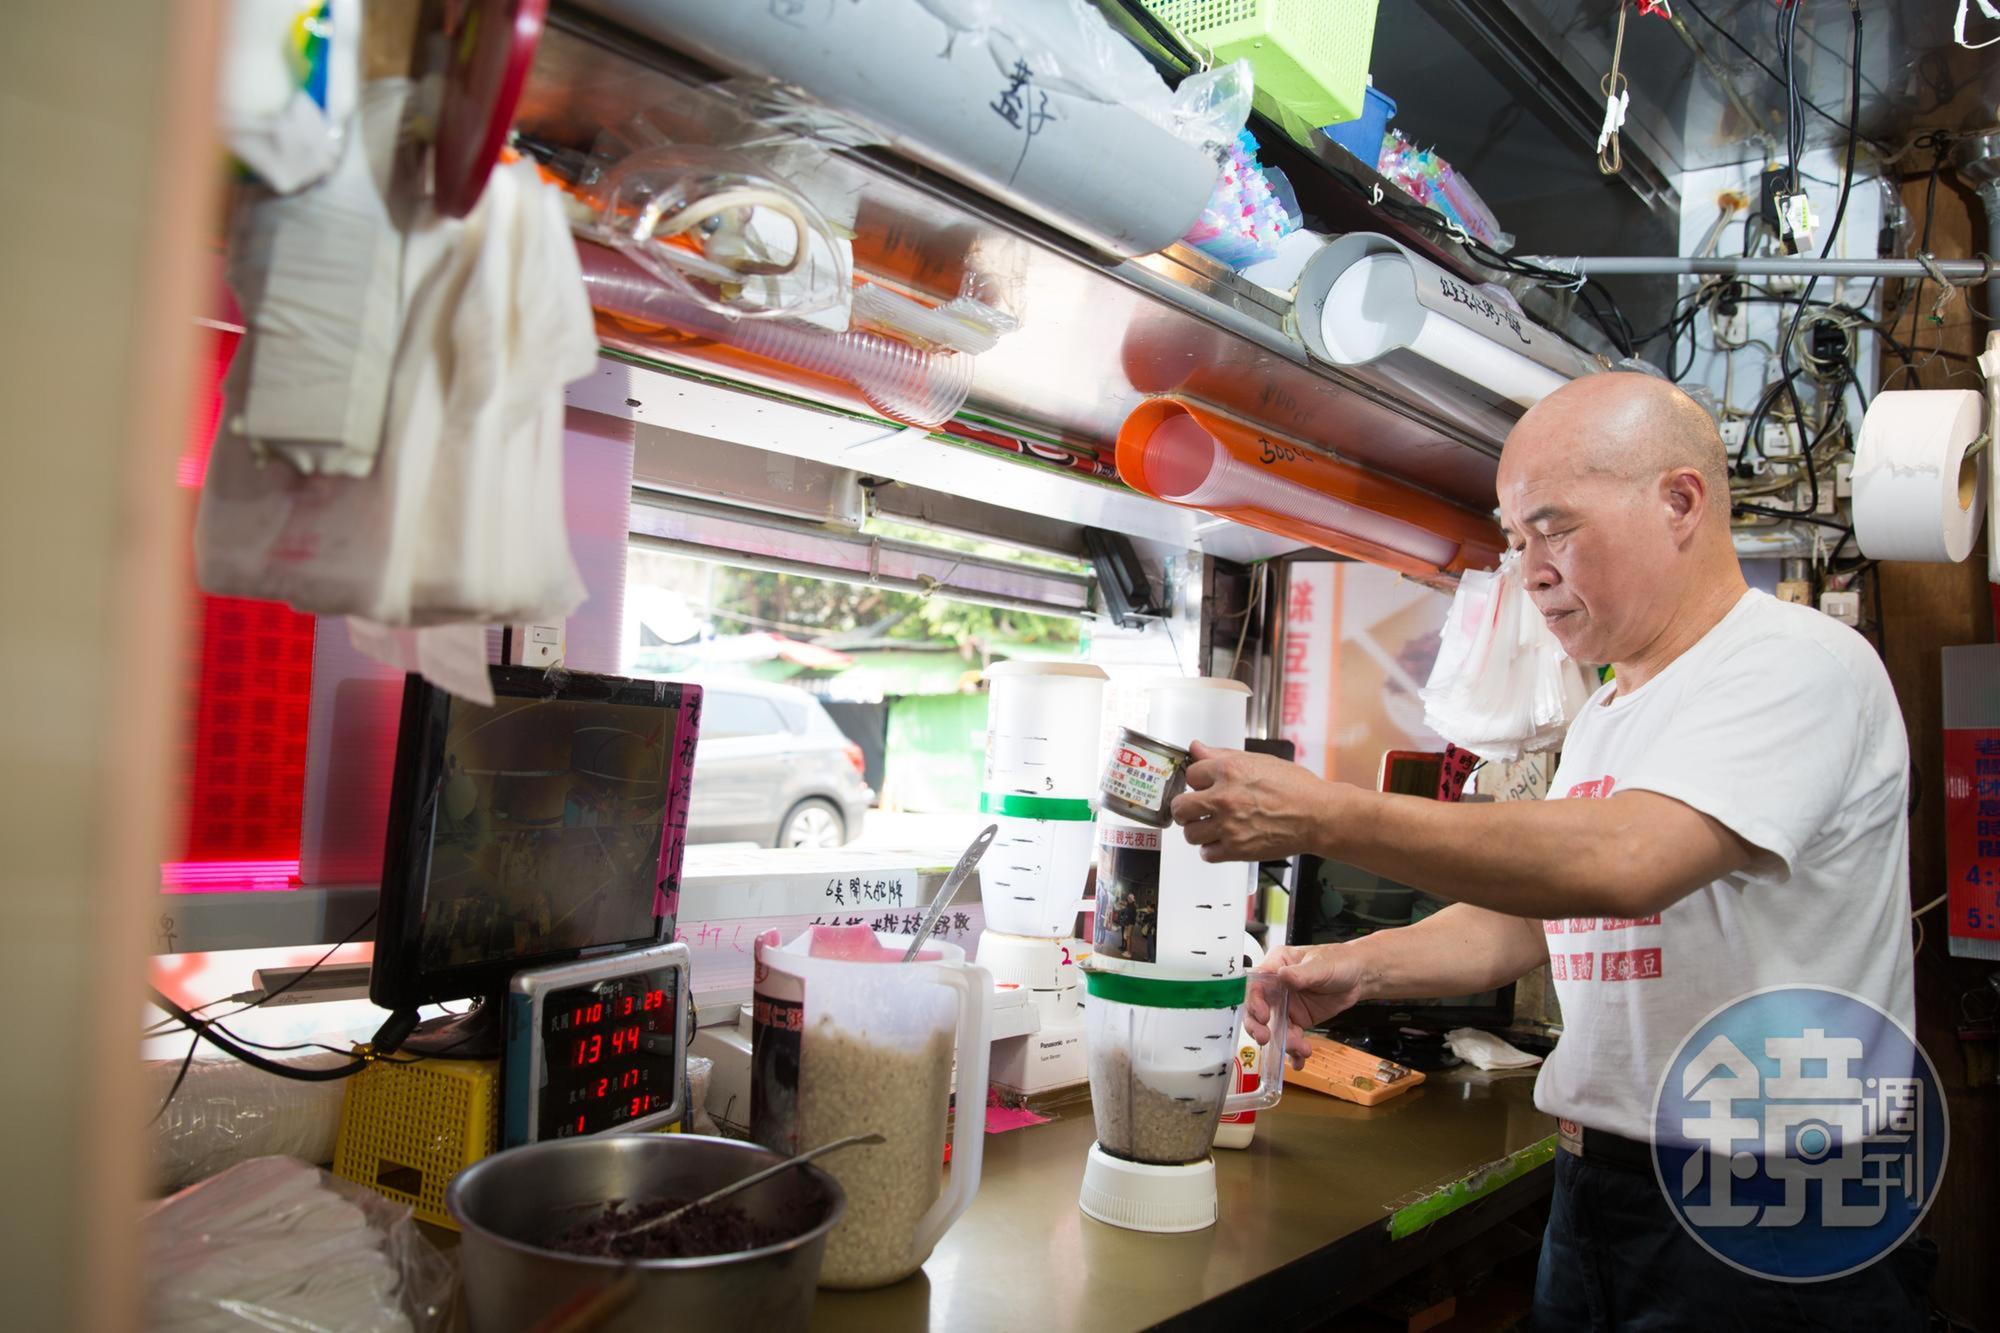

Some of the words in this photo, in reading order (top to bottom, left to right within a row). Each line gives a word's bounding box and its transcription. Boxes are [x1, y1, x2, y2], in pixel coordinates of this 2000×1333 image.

[574, 1003, 602, 1026] 110
[623, 997, 634, 1015] 3
[577, 1035, 602, 1065] 13
[612, 1027, 640, 1055] 44
[597, 1078, 609, 1097] 2
[623, 1068, 639, 1089] 17
[630, 1095, 650, 1117] 31
